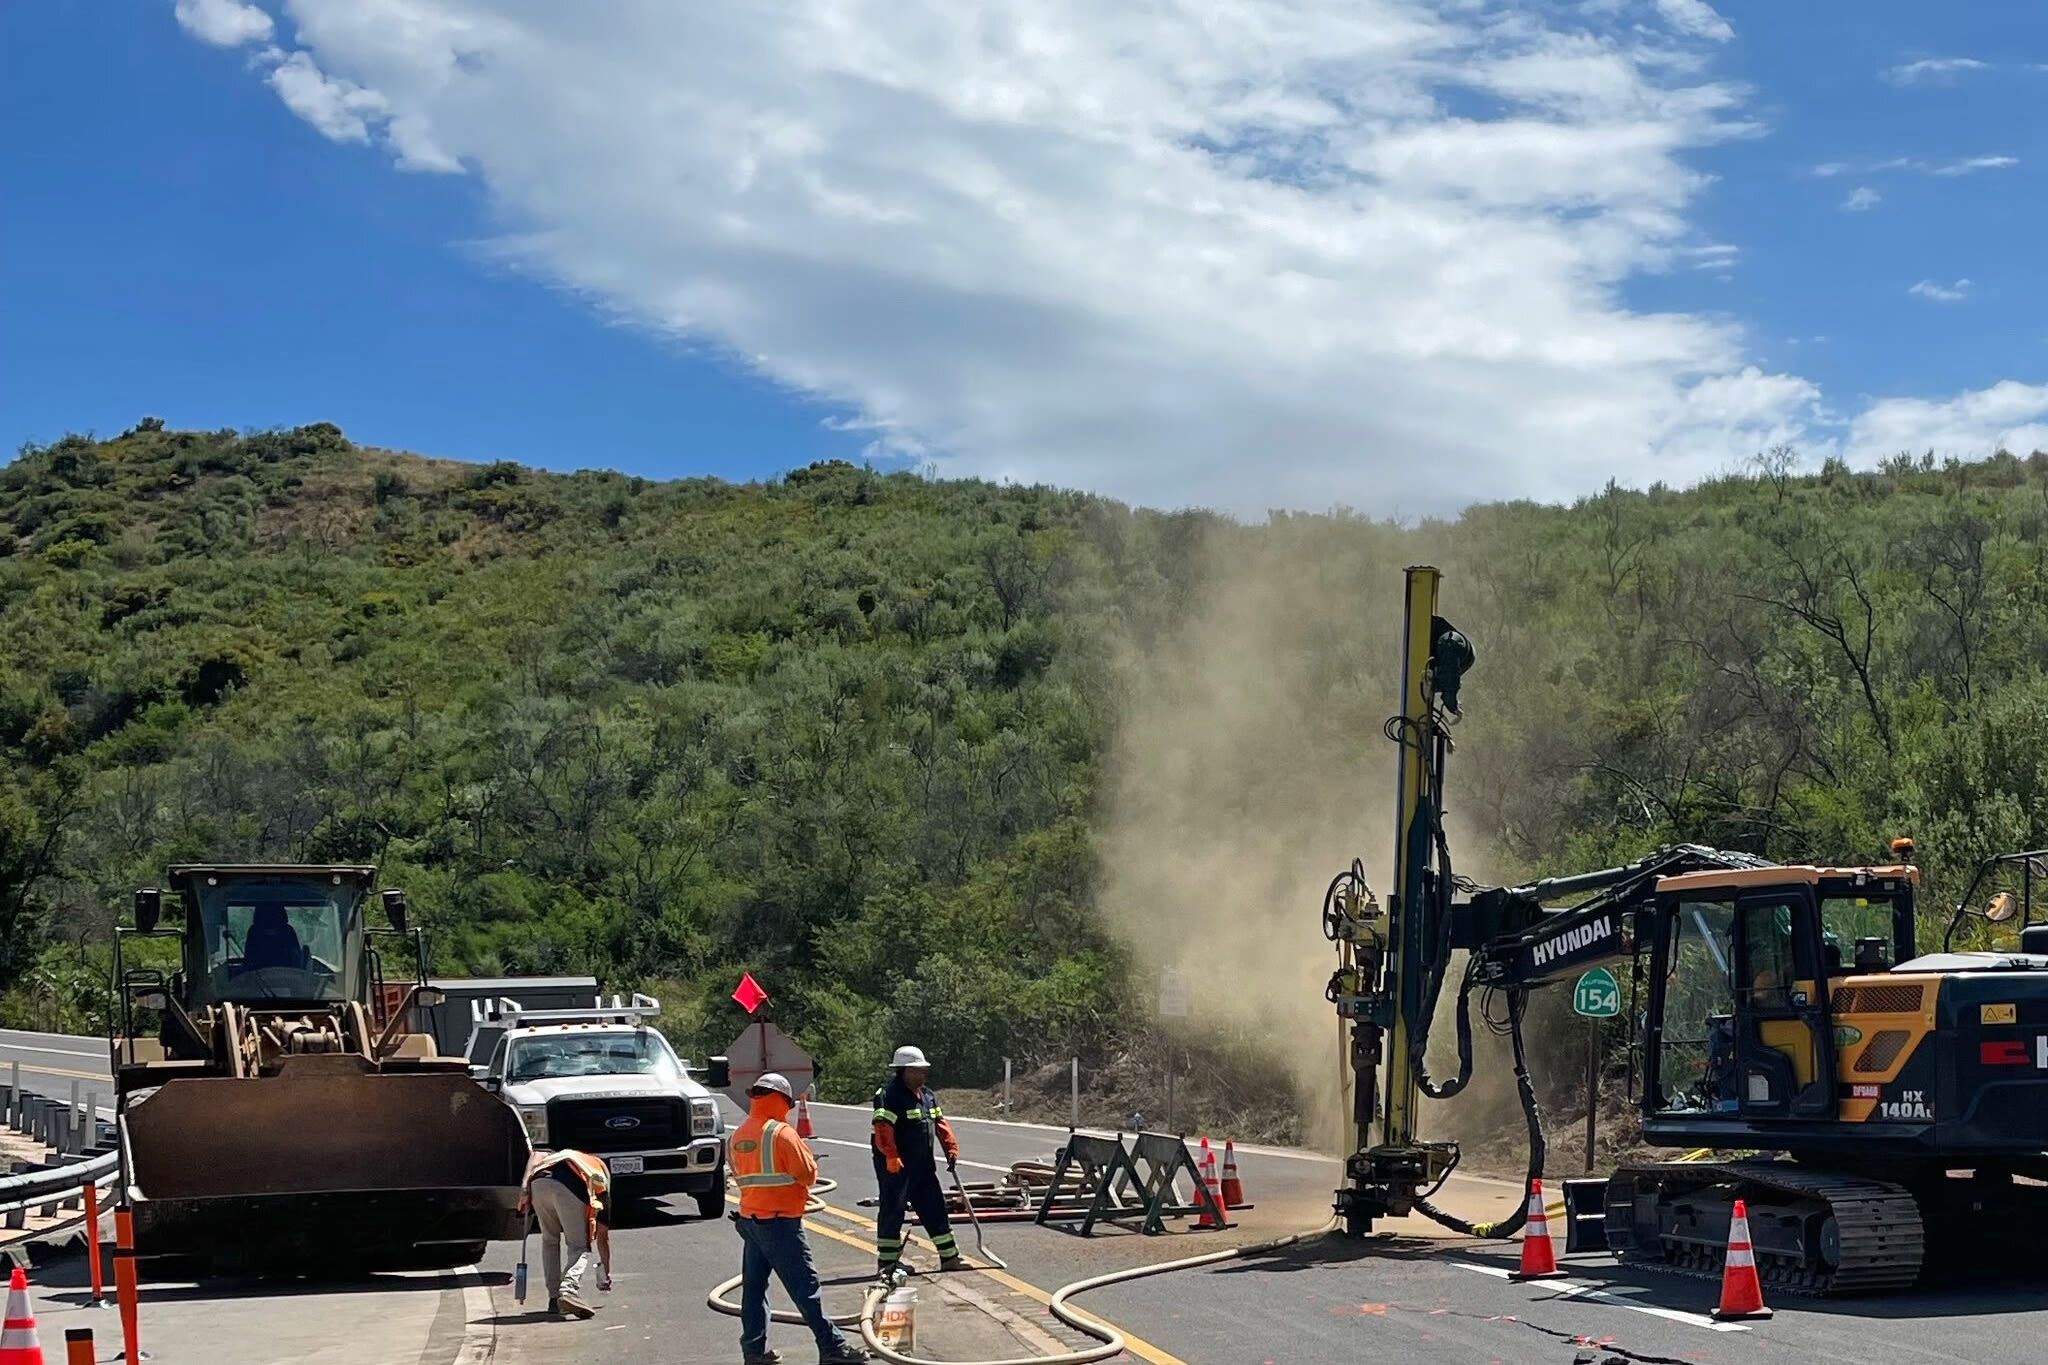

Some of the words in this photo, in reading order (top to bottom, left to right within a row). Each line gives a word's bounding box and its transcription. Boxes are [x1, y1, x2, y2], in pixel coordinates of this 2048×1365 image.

[1533, 916, 1612, 966] HYUNDAI
[1579, 989, 1617, 1012] 154
[1902, 1090, 1923, 1102] HX
